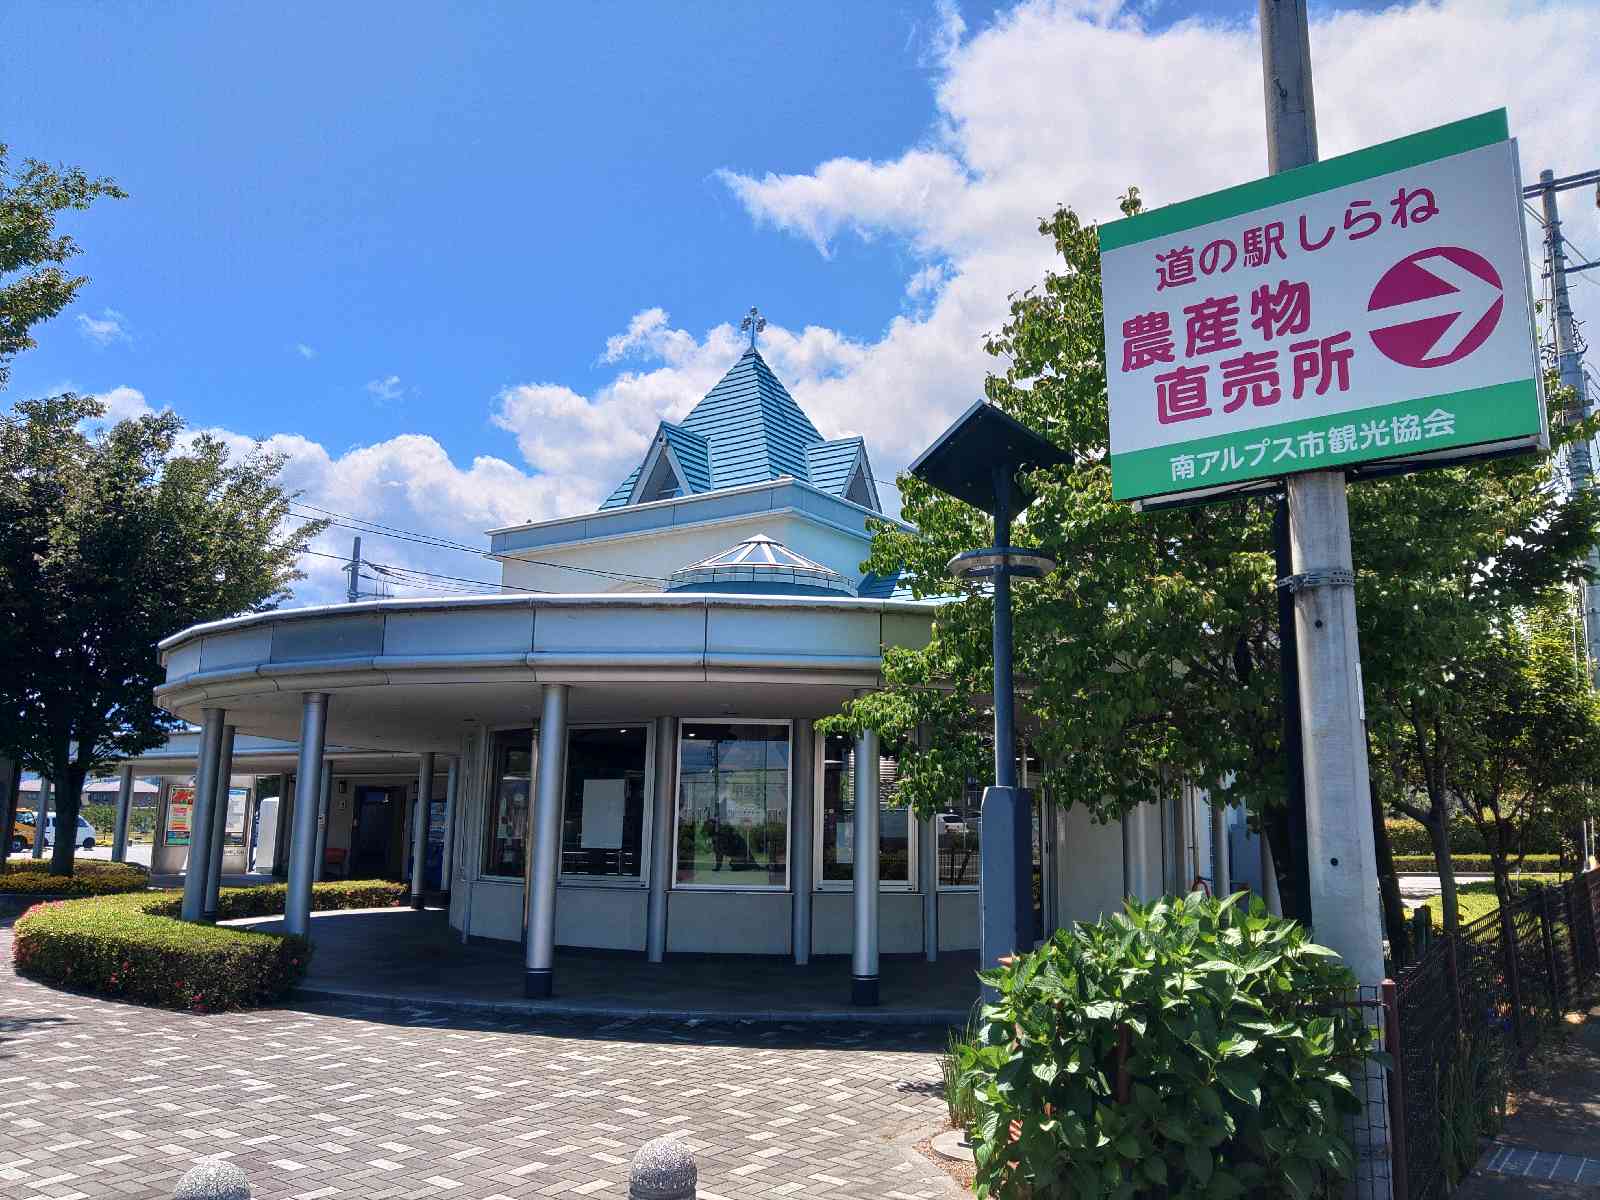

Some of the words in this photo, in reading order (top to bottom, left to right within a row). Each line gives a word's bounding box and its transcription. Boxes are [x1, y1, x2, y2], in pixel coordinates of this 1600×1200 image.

[1155, 187, 1440, 292] 道の駅しらね
[1121, 279, 1312, 373] 農産物
[1153, 330, 1355, 425] 直売所
[1169, 407, 1457, 482] 南アルプス市観光協会
